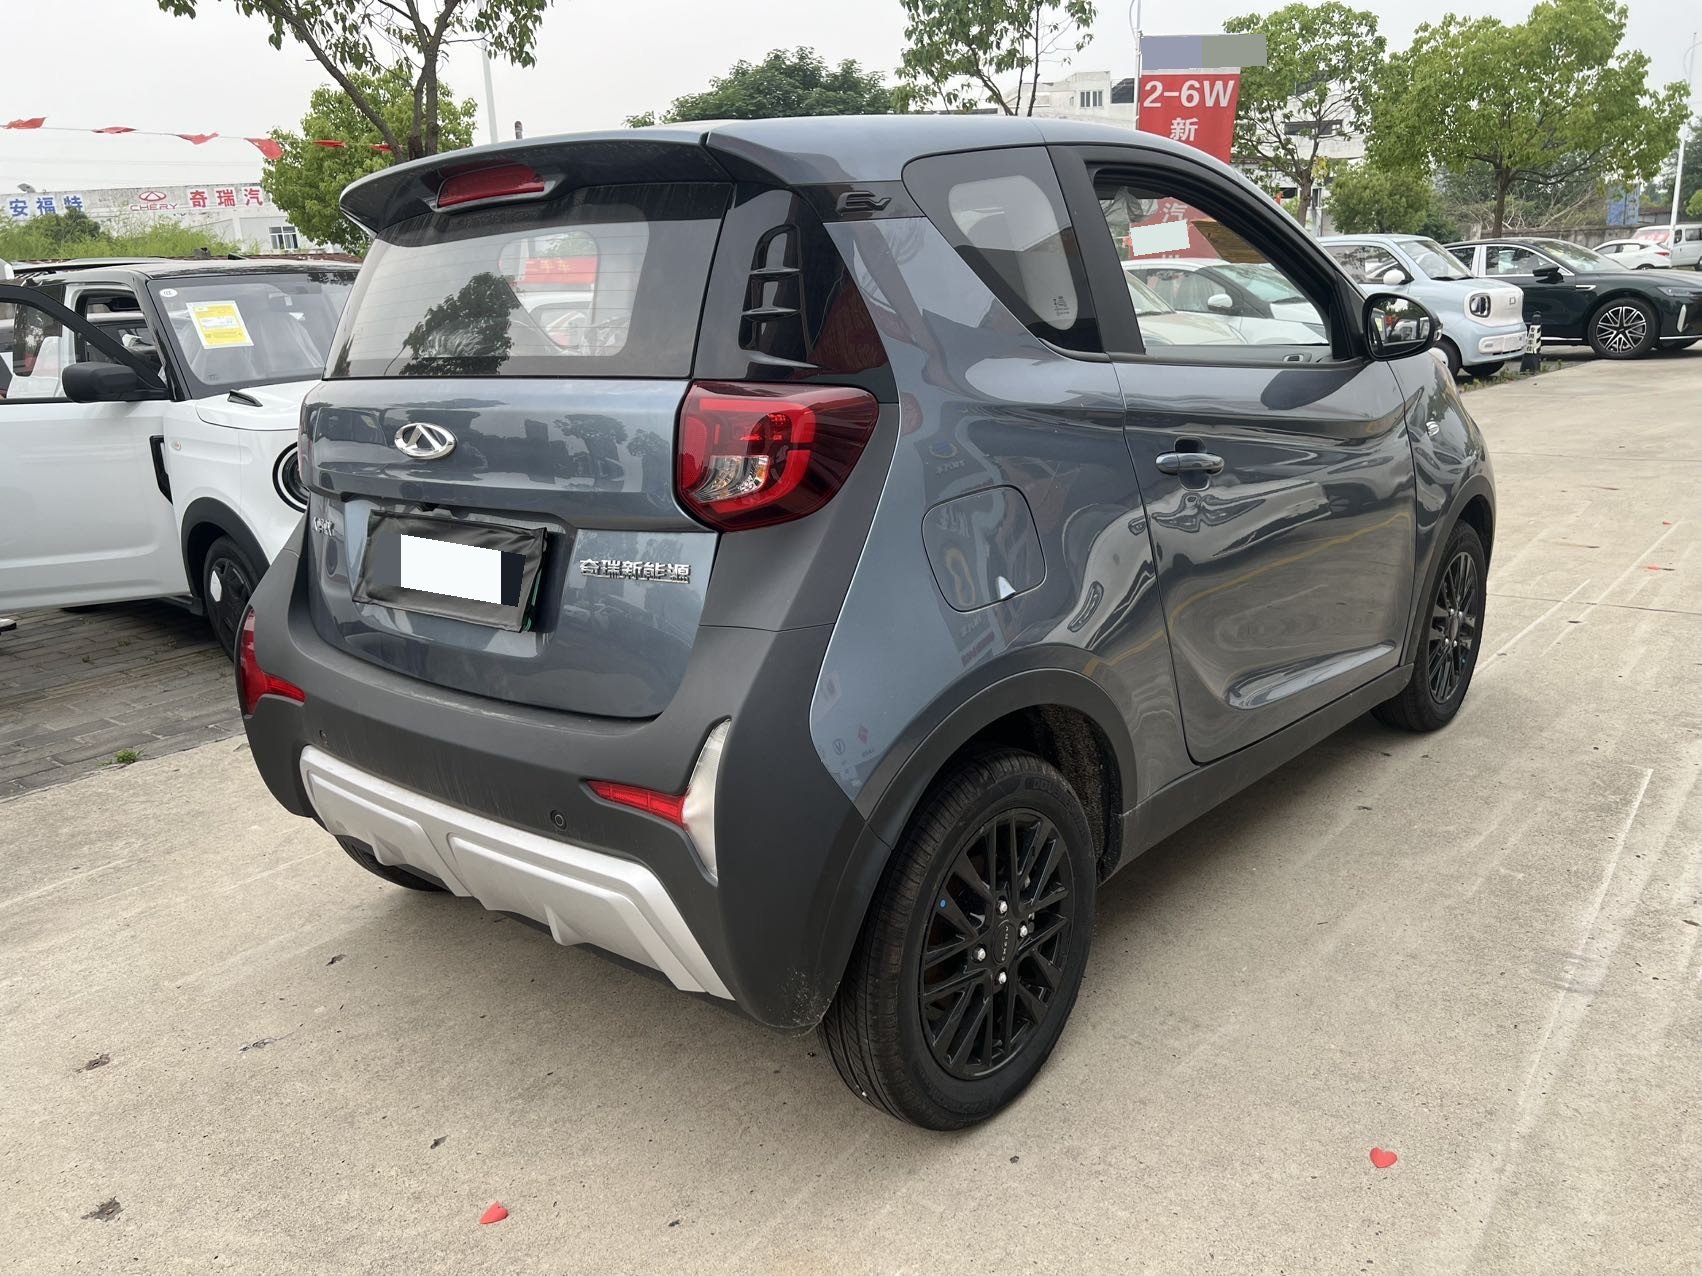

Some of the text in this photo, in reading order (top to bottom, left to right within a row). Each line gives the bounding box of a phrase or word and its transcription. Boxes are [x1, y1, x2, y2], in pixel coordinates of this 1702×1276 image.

[1143, 79, 1235, 108] 2-6W
[1169, 117, 1199, 141] 新
[9, 195, 83, 217] 安福特
[129, 203, 178, 212] CHERY
[189, 187, 263, 208] 奇瑞汽
[579, 558, 690, 582] 奇瑞新能源
